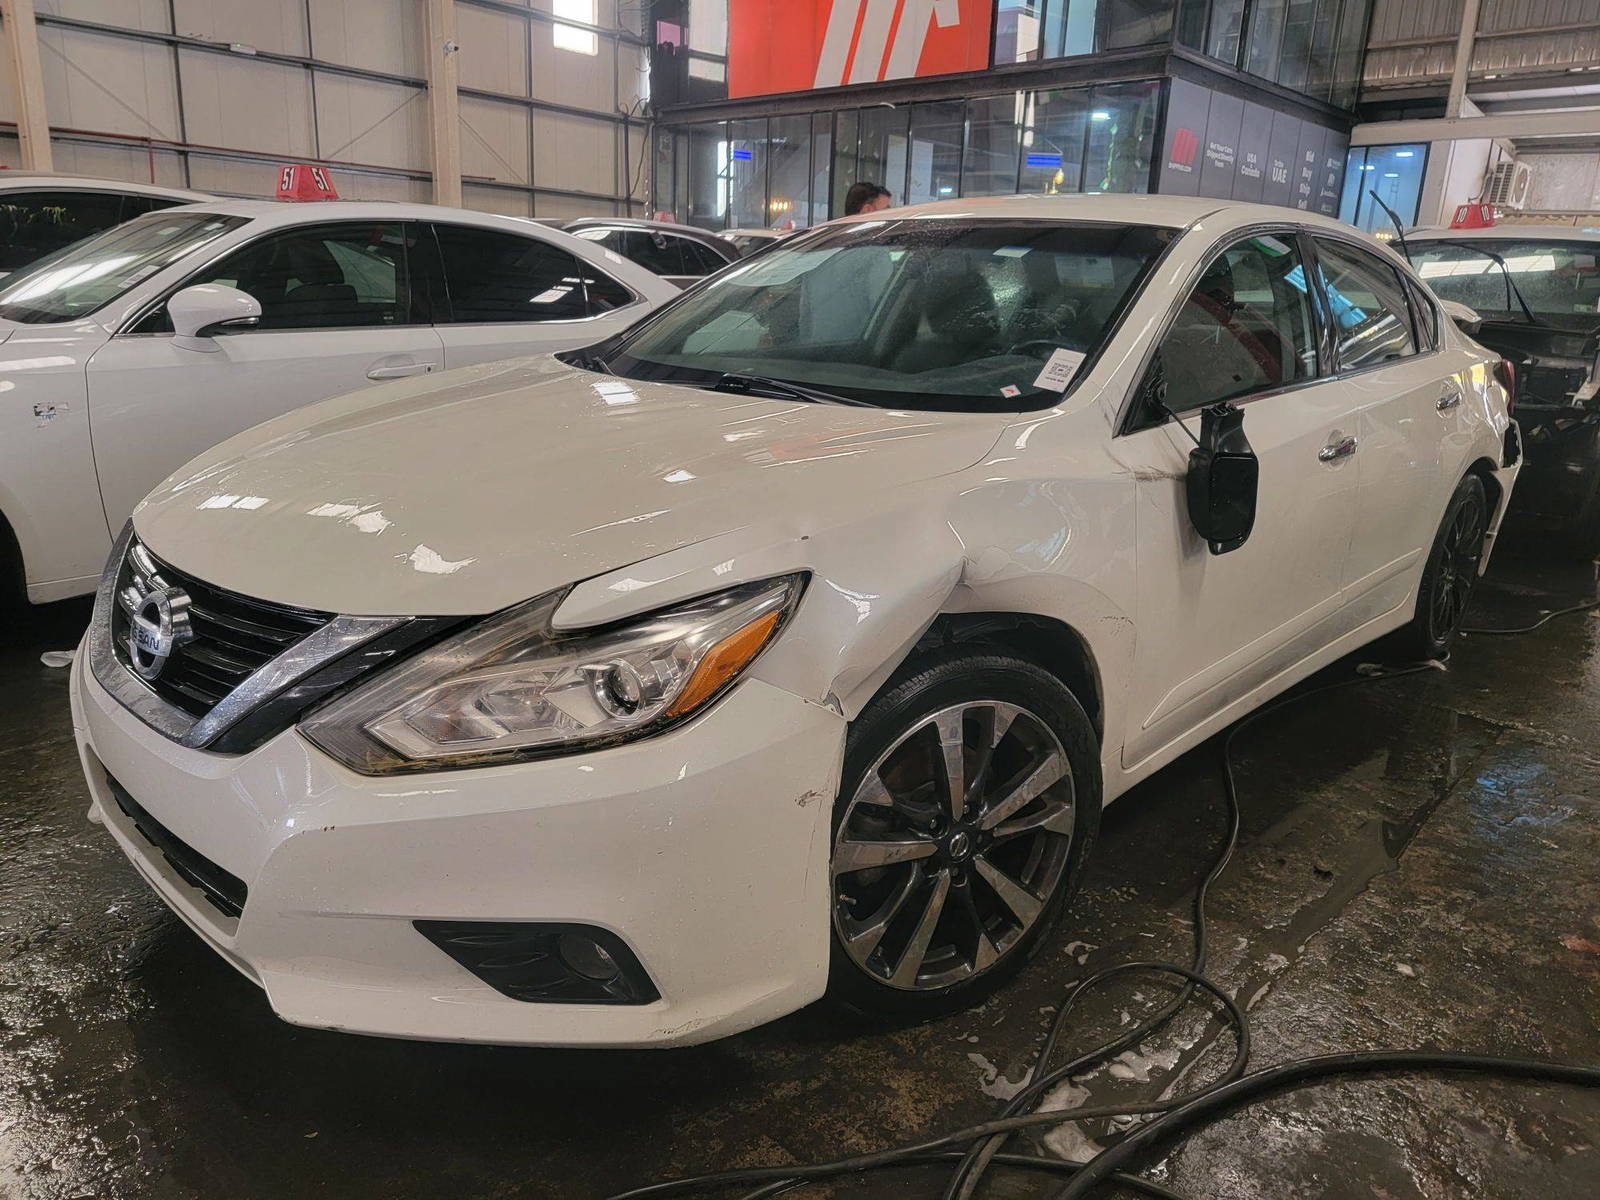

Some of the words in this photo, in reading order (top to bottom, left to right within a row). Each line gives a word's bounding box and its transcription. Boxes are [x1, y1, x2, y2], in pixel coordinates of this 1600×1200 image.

[1247, 153, 1257, 163] USA
[282, 168, 295, 190] 51
[311, 168, 330, 191] 51
[1272, 167, 1287, 184] UAE
[1456, 207, 1468, 223] 10
[1481, 205, 1490, 222] 10
